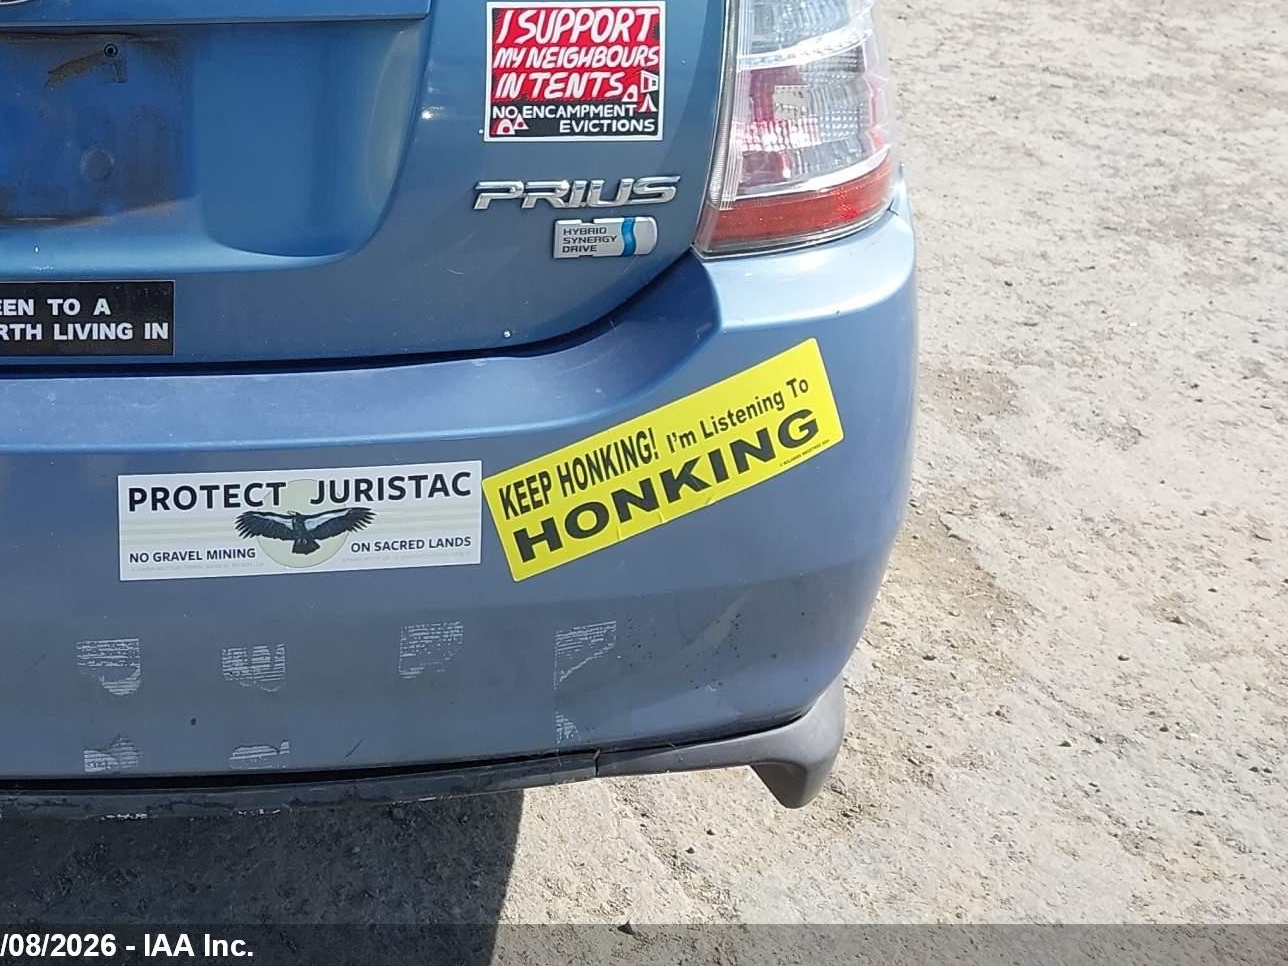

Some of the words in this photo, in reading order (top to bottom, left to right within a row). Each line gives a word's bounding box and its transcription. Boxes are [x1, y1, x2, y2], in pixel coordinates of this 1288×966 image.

[496, 8, 512, 44] I
[515, 8, 660, 45] SUPPORT
[493, 47, 525, 69] MY
[525, 45, 659, 70] NEIGHBOURS
[495, 72, 526, 99] IN
[529, 71, 626, 99] TENTS
[493, 105, 518, 120] NO
[523, 104, 638, 119] ENCAMPMENT
[559, 119, 656, 134] EVICTIONS
[473, 175, 681, 211] PRIUS
[562, 235, 618, 244] SYNERGY
[563, 226, 608, 235] HYBRID
[562, 245, 598, 253] DRIVE
[47, 298, 81, 316] TO
[93, 298, 111, 315] A
[53, 322, 133, 341] LIVING
[144, 322, 169, 340] IN
[499, 470, 553, 520] KEEP
[557, 427, 659, 498] HONKING!
[666, 430, 697, 454] I'm
[699, 390, 786, 440] Listening
[786, 377, 809, 399] To
[128, 481, 287, 512] PROTECT
[309, 471, 473, 506] JURISTAC
[513, 408, 820, 563] HONKING
[350, 542, 371, 553] ON
[373, 539, 425, 552] SACRED
[428, 536, 472, 549] LANDS
[129, 552, 150, 563] NO
[152, 550, 203, 563] GRAVEL
[206, 547, 257, 561] MINING
